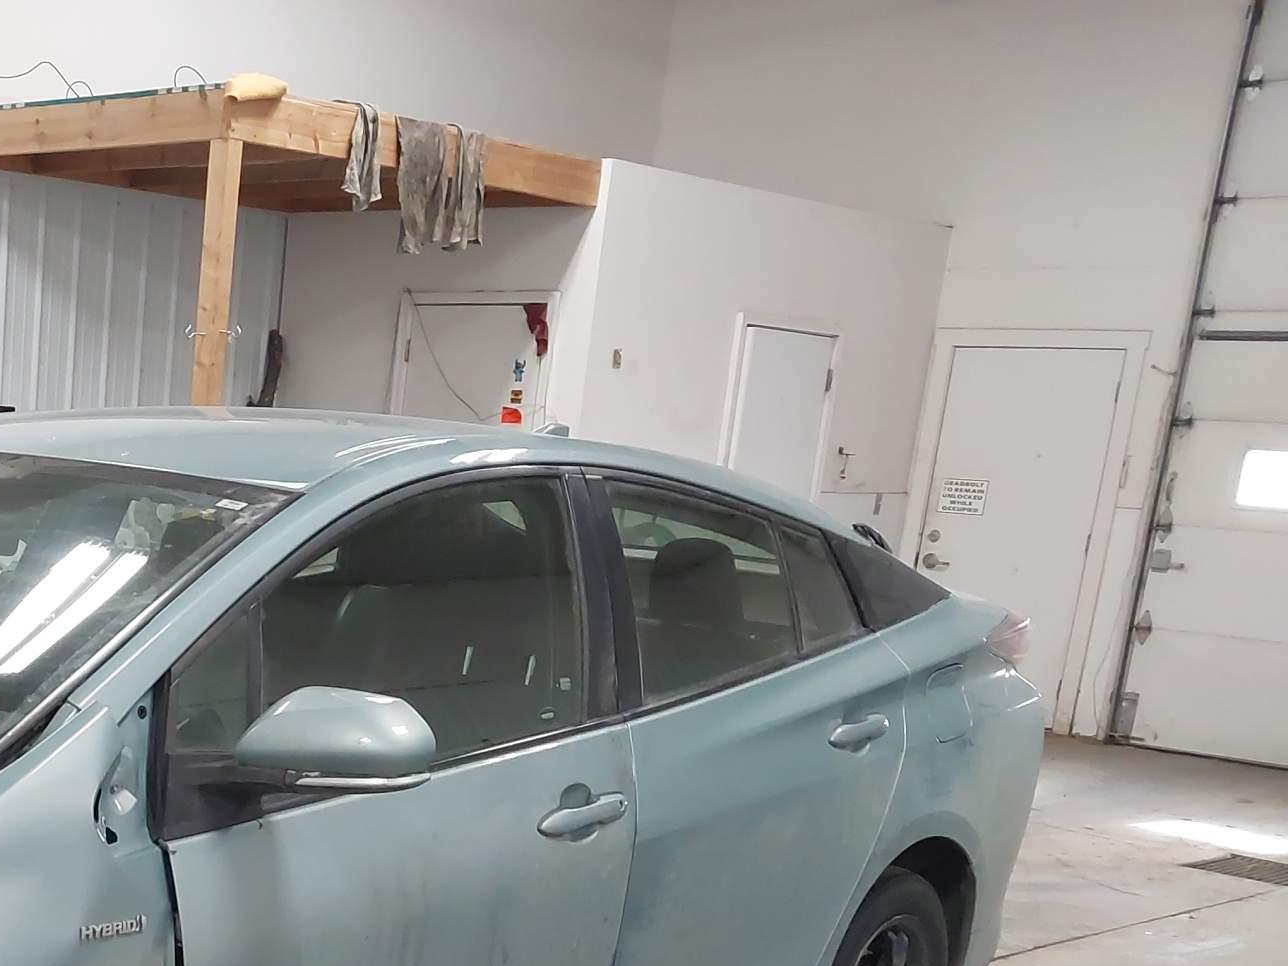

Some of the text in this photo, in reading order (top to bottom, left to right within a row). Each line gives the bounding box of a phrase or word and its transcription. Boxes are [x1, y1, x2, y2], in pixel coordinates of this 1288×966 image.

[944, 480, 985, 489] DEADBOLT
[942, 493, 983, 501] UNLOCKED
[942, 505, 979, 513] OCCUPIED
[80, 919, 138, 940] HYBRID
